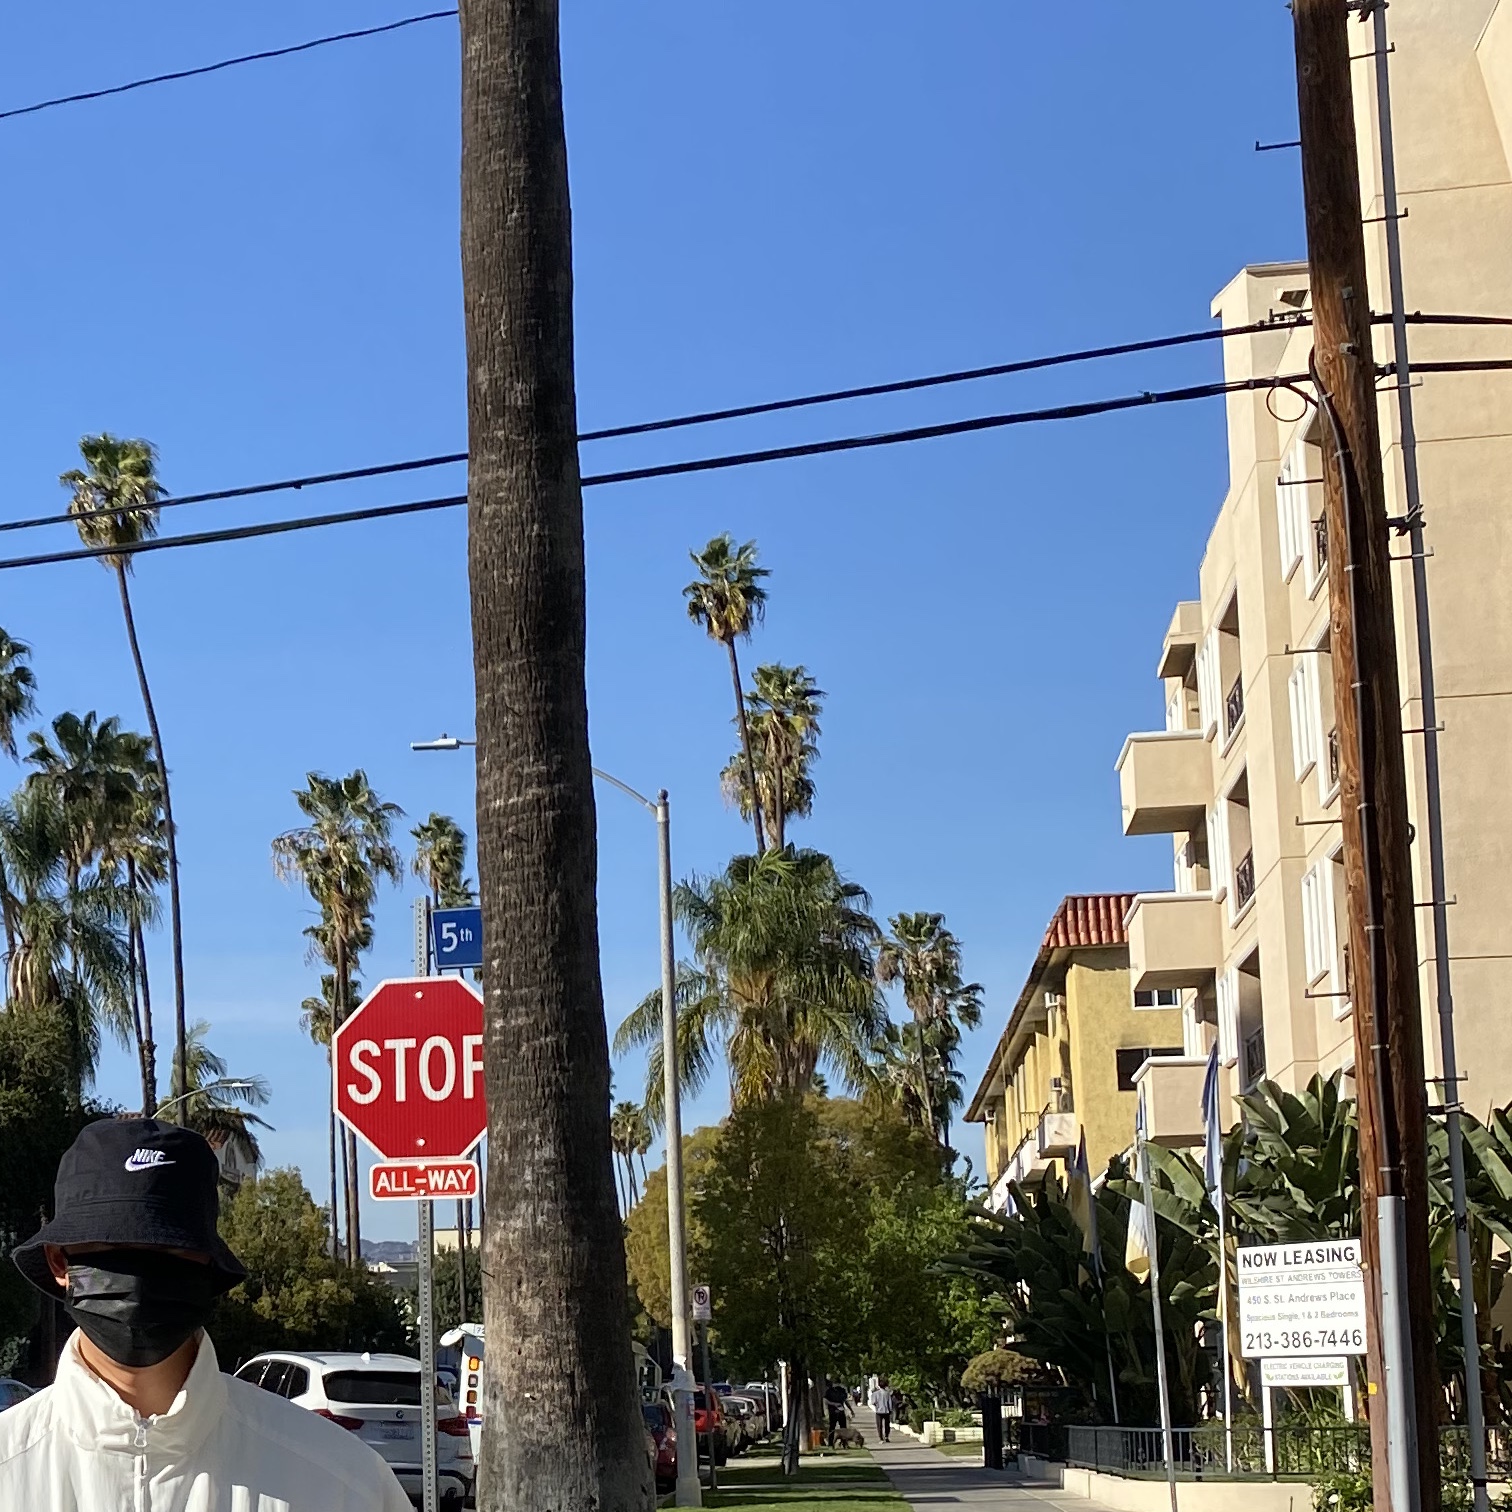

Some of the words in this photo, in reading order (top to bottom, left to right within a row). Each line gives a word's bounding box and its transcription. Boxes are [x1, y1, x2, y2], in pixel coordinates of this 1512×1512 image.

[441, 922, 473, 953] 5th
[132, 1148, 166, 1163] NIKE
[375, 1168, 473, 1193] ALL-WAY
[1242, 1251, 1277, 1268] NOW
[1283, 1246, 1355, 1266] LEASING
[1288, 1272, 1326, 1282] ANDREWS
[1328, 1269, 1362, 1280] TOWERS
[1247, 1295, 1262, 1305] 450
[1288, 1292, 1328, 1303] Andrews
[1330, 1291, 1356, 1301] Place
[1320, 1310, 1359, 1319] Bedrooms
[1246, 1328, 1363, 1350] 213-386-7446
